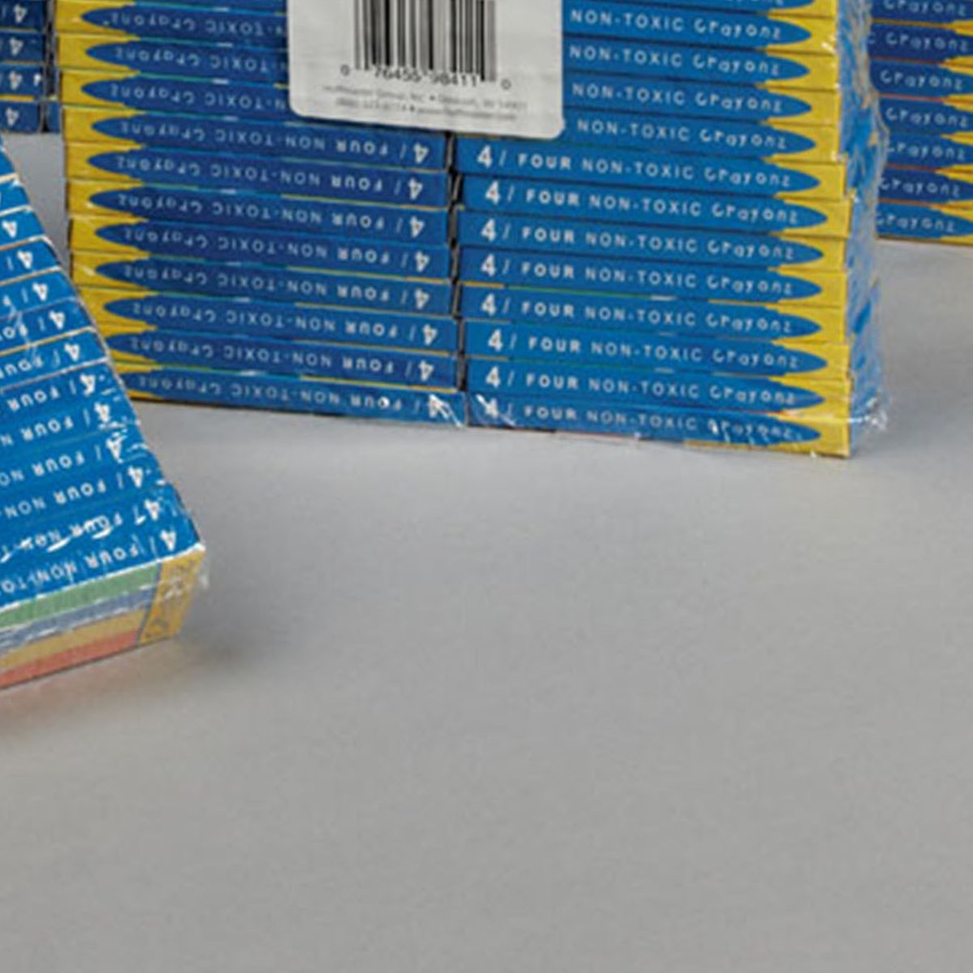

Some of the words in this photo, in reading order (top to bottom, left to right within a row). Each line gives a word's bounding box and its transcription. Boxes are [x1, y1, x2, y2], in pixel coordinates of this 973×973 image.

[340, 64, 350, 76] 0
[500, 78, 511, 90] 0
[518, 152, 571, 169] FOUR
[581, 157, 694, 180] NON-TOXIC
[332, 213, 384, 229] FOUR
[521, 226, 574, 243] FOUR
[585, 232, 697, 253] NON-TOXIC
[345, 321, 397, 338] FOUR
[525, 373, 578, 389] FOUR
[588, 378, 699, 398] NON-TOXIC
[7, 386, 59, 411] FOUR
[31, 451, 85, 476] FOUR
